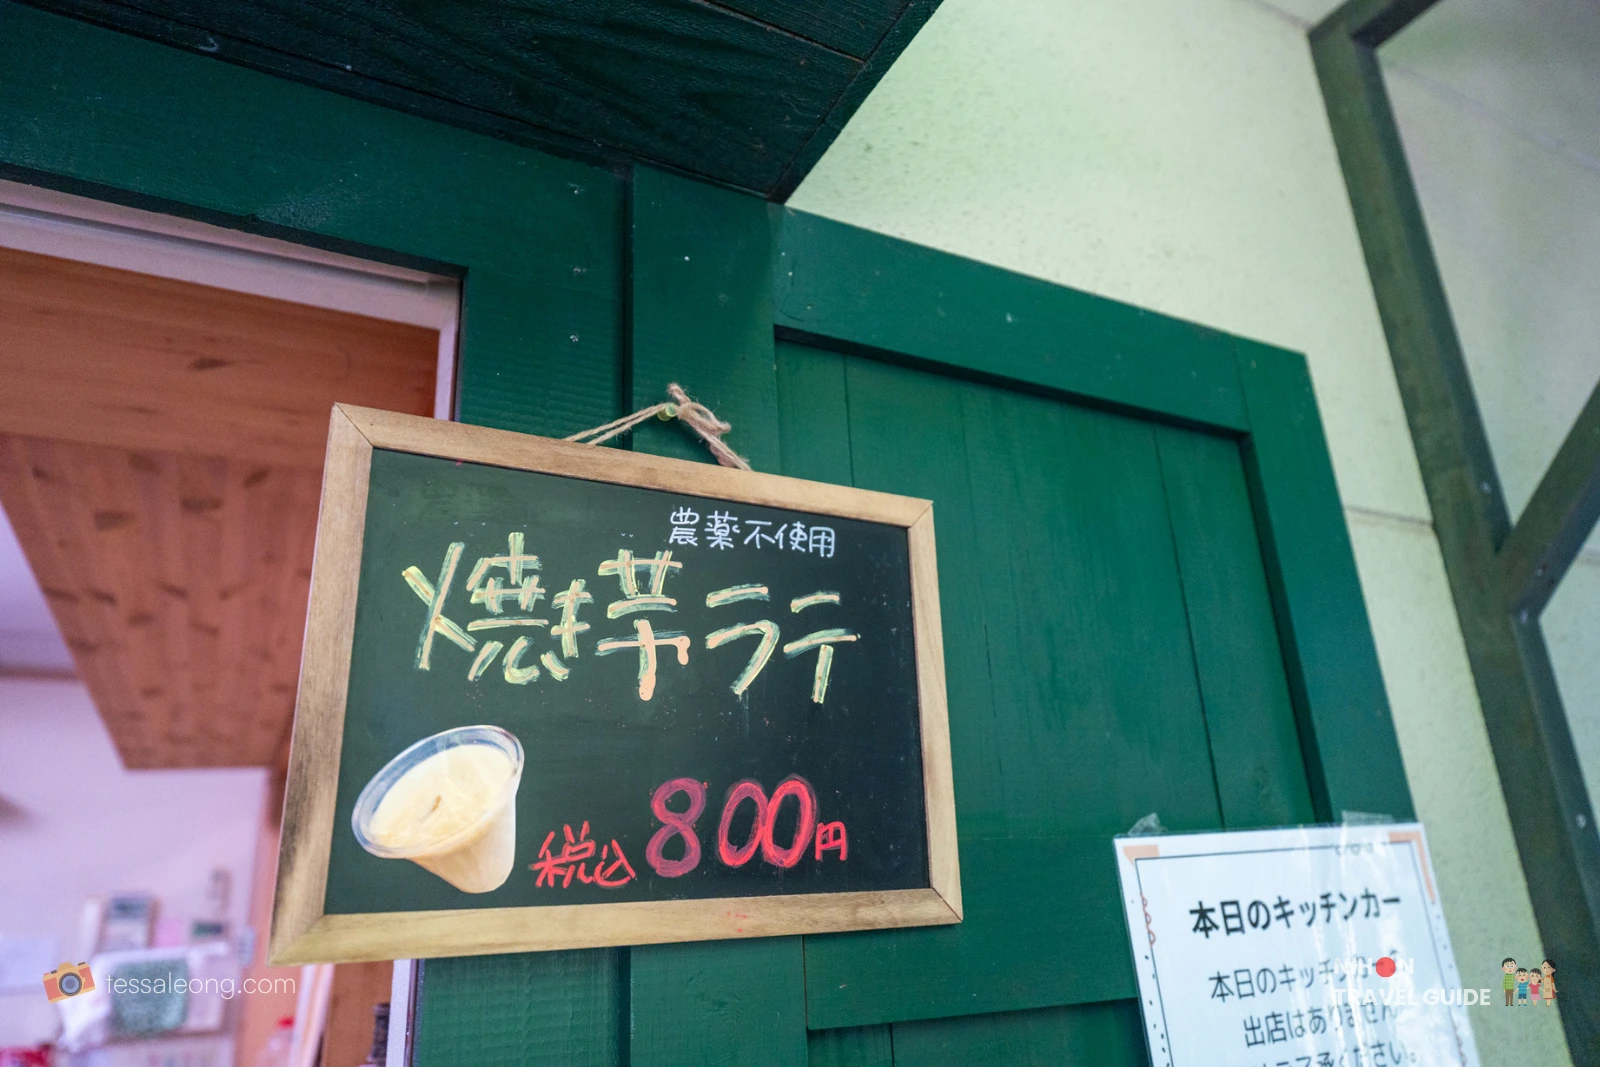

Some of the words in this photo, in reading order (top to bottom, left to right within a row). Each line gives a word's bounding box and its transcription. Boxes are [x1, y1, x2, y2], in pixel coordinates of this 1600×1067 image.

[667, 505, 837, 559] 農薬不使用
[402, 530, 861, 705] 焼き芋ラテ
[1188, 887, 1402, 940] 本日のキッチンカー
